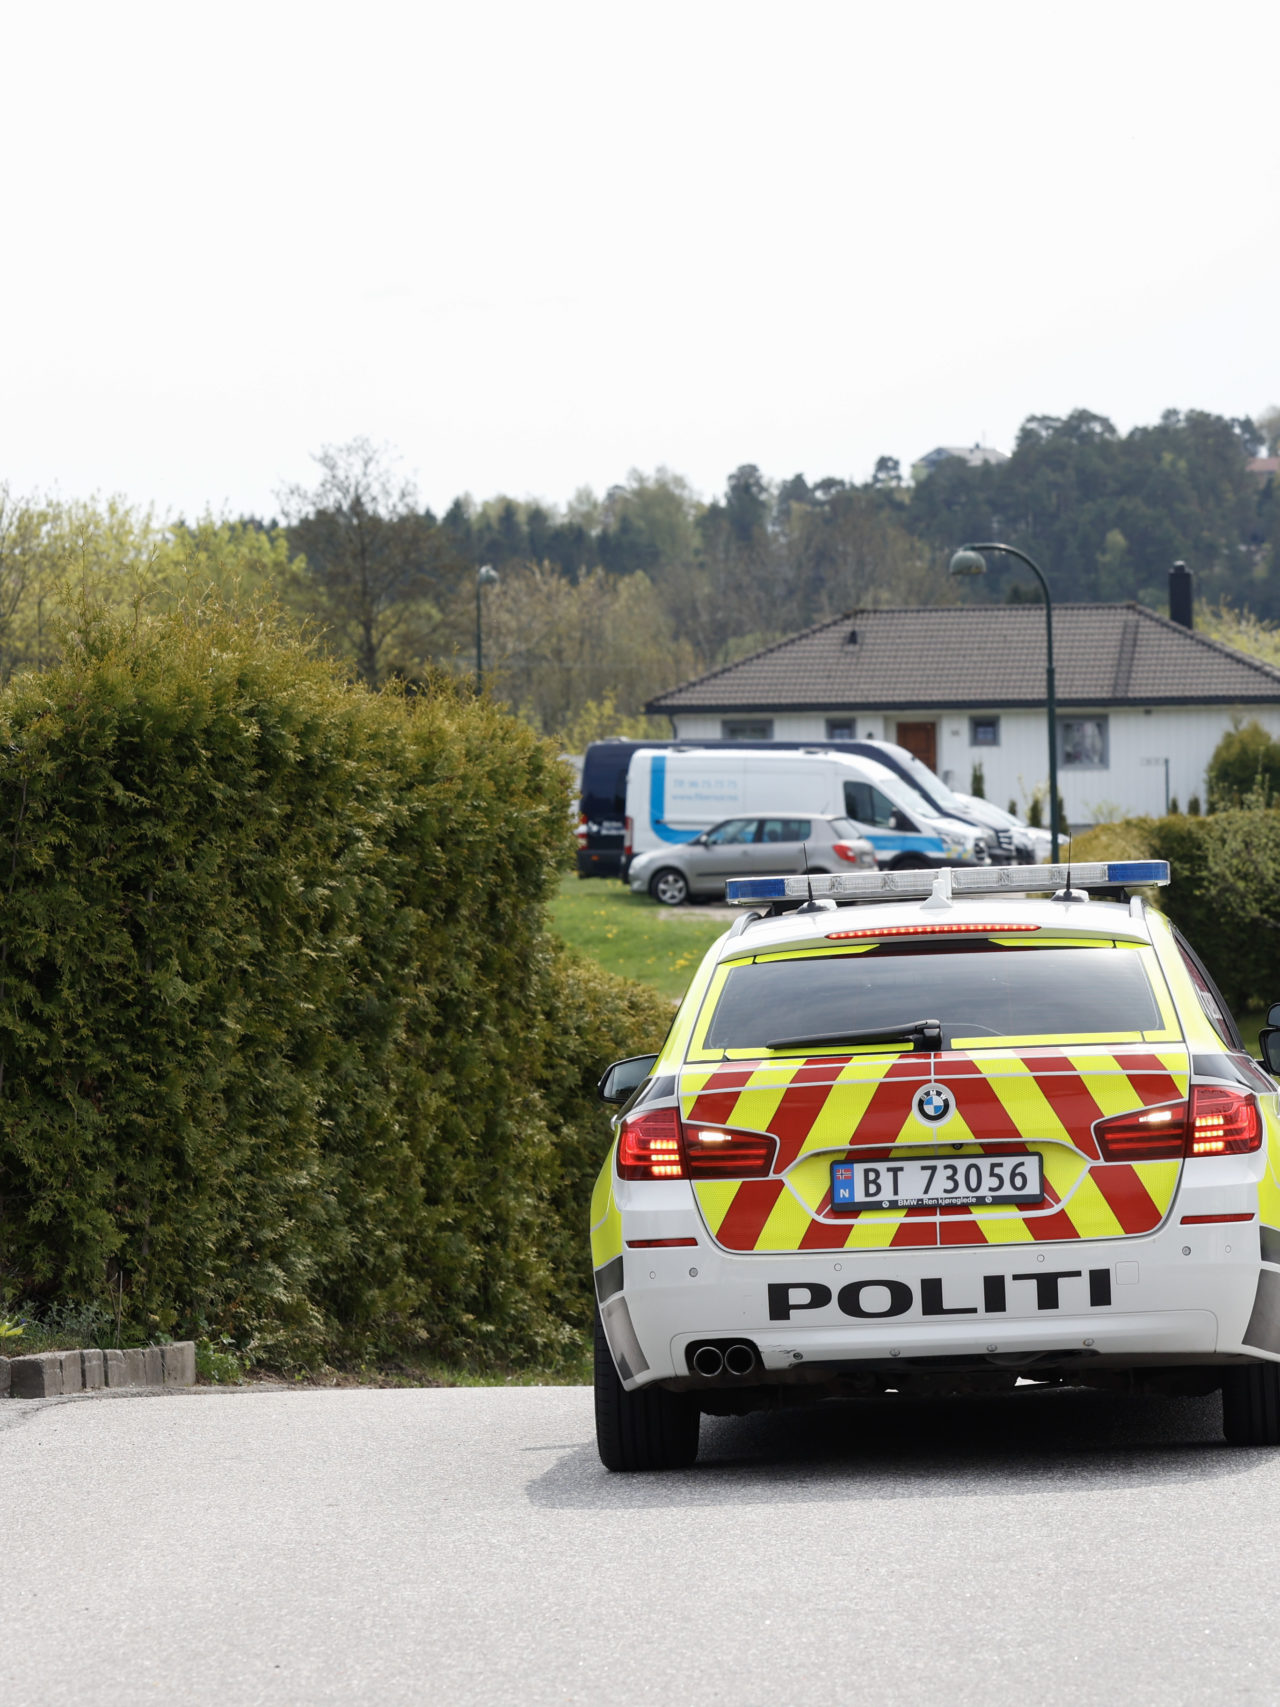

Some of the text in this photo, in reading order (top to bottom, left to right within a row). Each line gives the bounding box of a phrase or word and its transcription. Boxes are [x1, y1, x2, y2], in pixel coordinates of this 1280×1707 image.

[863, 1161, 1028, 1198] BT 73056
[839, 1188, 849, 1198] N
[938, 1196, 977, 1205] kjøreglede
[767, 1268, 1112, 1321] POLITI
